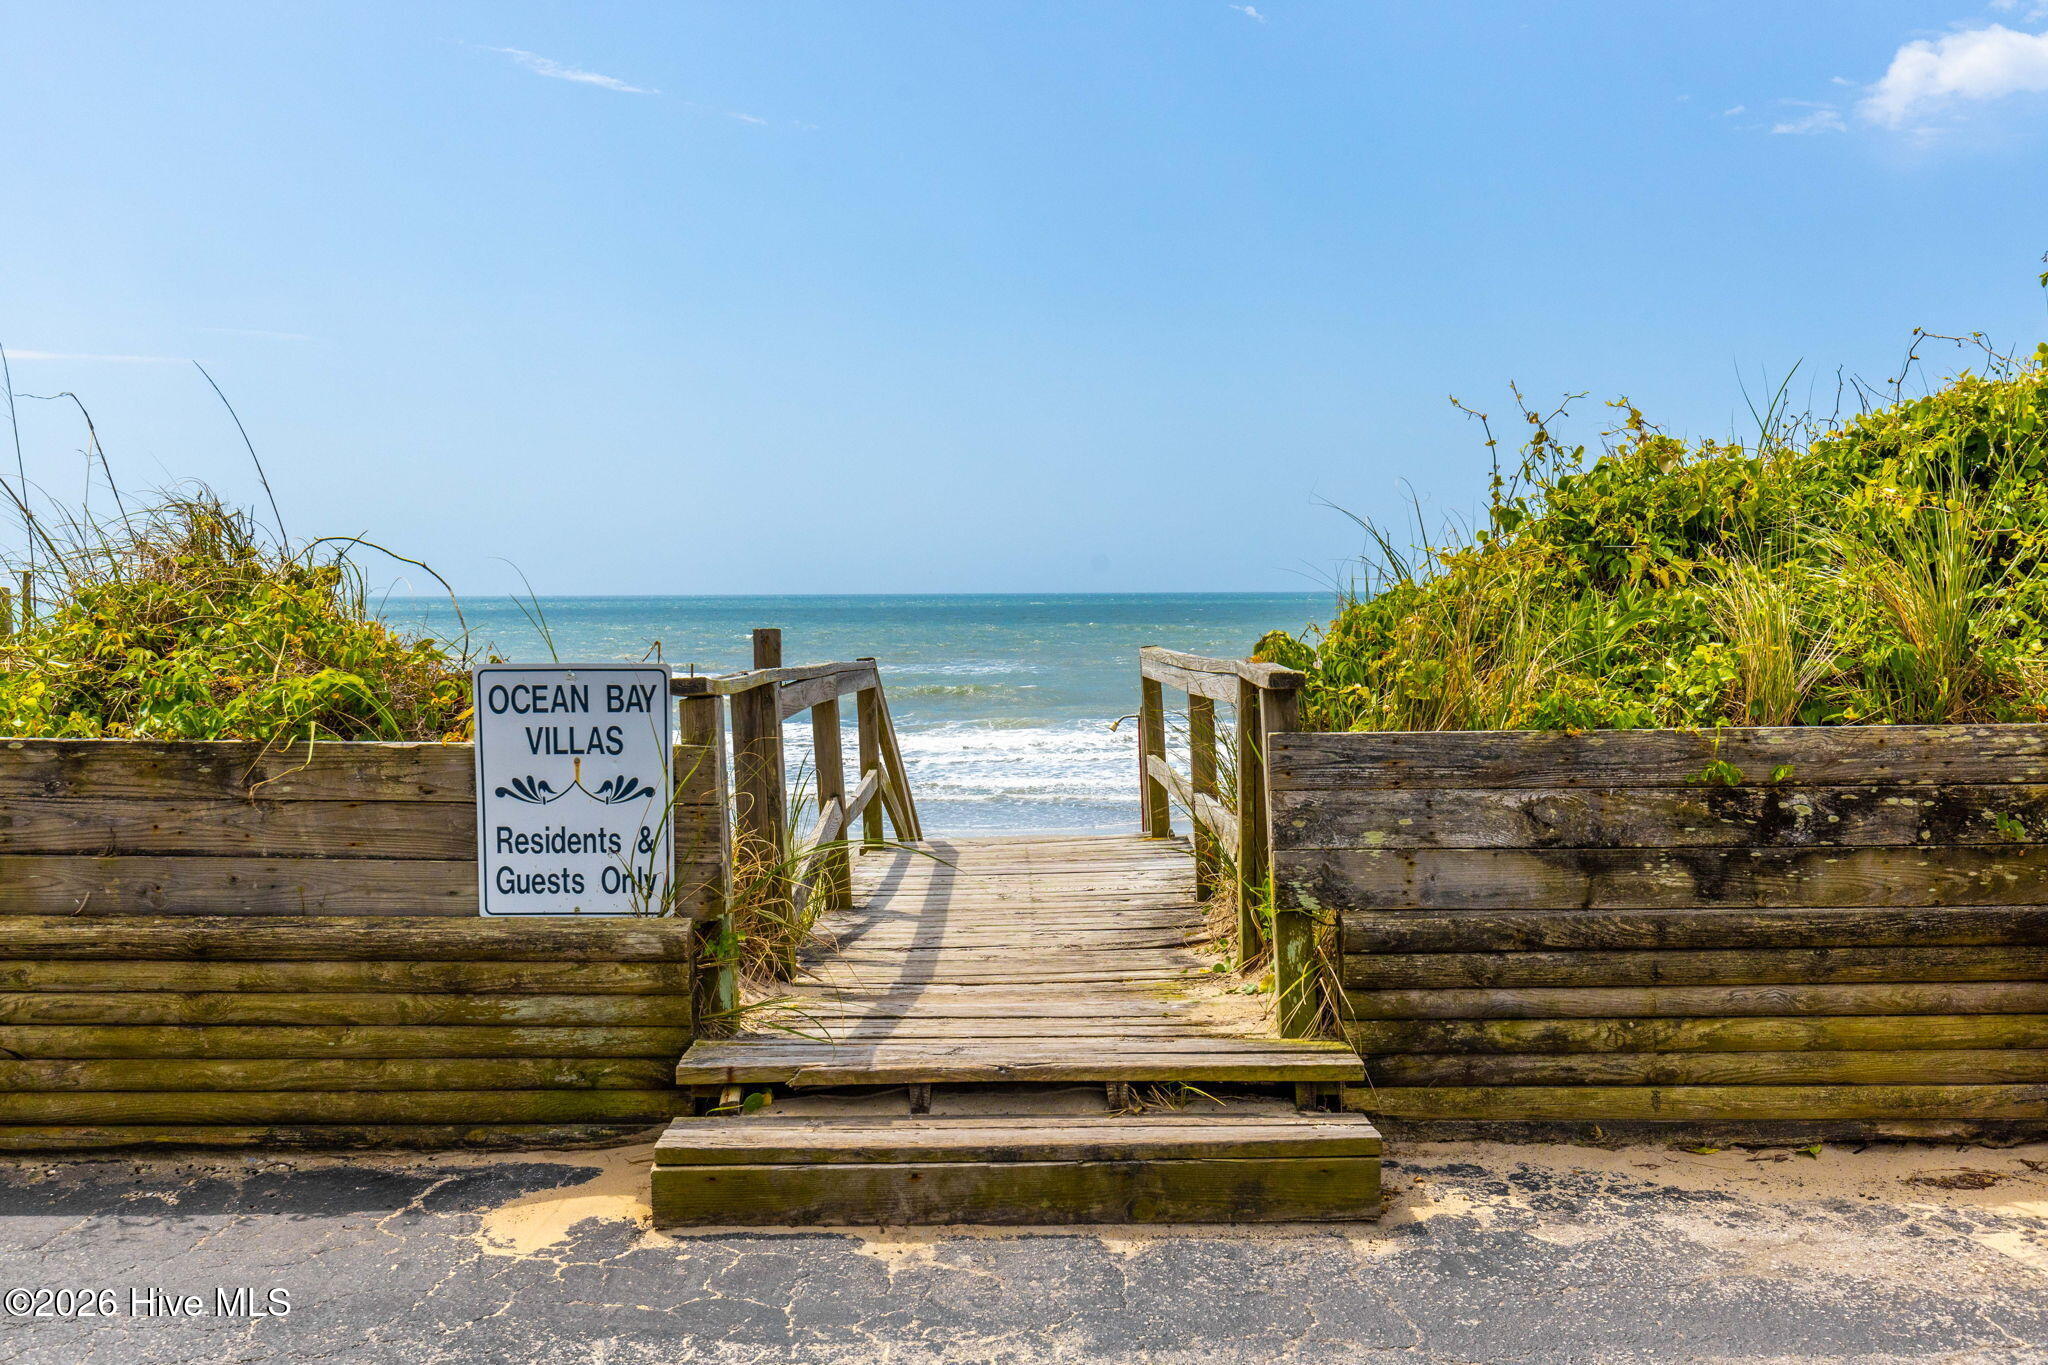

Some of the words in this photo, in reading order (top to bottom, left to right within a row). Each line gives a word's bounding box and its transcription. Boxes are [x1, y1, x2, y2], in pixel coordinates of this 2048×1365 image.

[488, 684, 589, 715] OCEAN
[606, 684, 658, 713] BAY
[525, 725, 624, 755] VILLAS
[496, 826, 622, 854] Residents
[637, 825, 655, 854] &
[496, 866, 585, 895] Guests
[601, 866, 657, 899] Only
